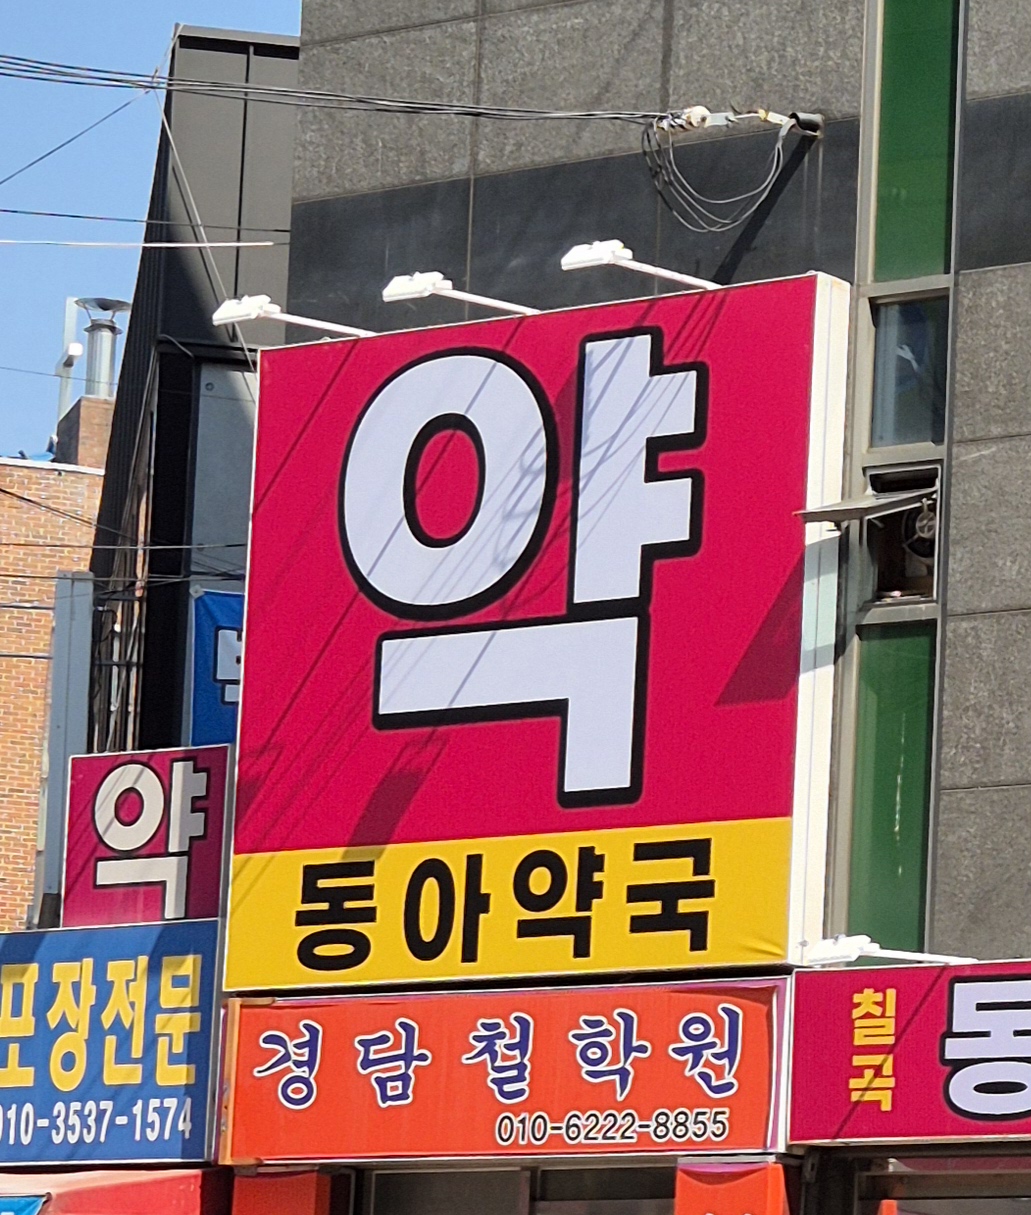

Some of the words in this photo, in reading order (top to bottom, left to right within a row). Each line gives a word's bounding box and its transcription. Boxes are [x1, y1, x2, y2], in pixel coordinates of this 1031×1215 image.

[339, 325, 709, 808] 약
[92, 760, 209, 920] 약
[294, 837, 716, 972] 동아약국
[0, 955, 202, 1092] 포장전문
[848, 987, 897, 1113] 칠곡
[495, 1108, 730, 1146] 010-6222-8855
